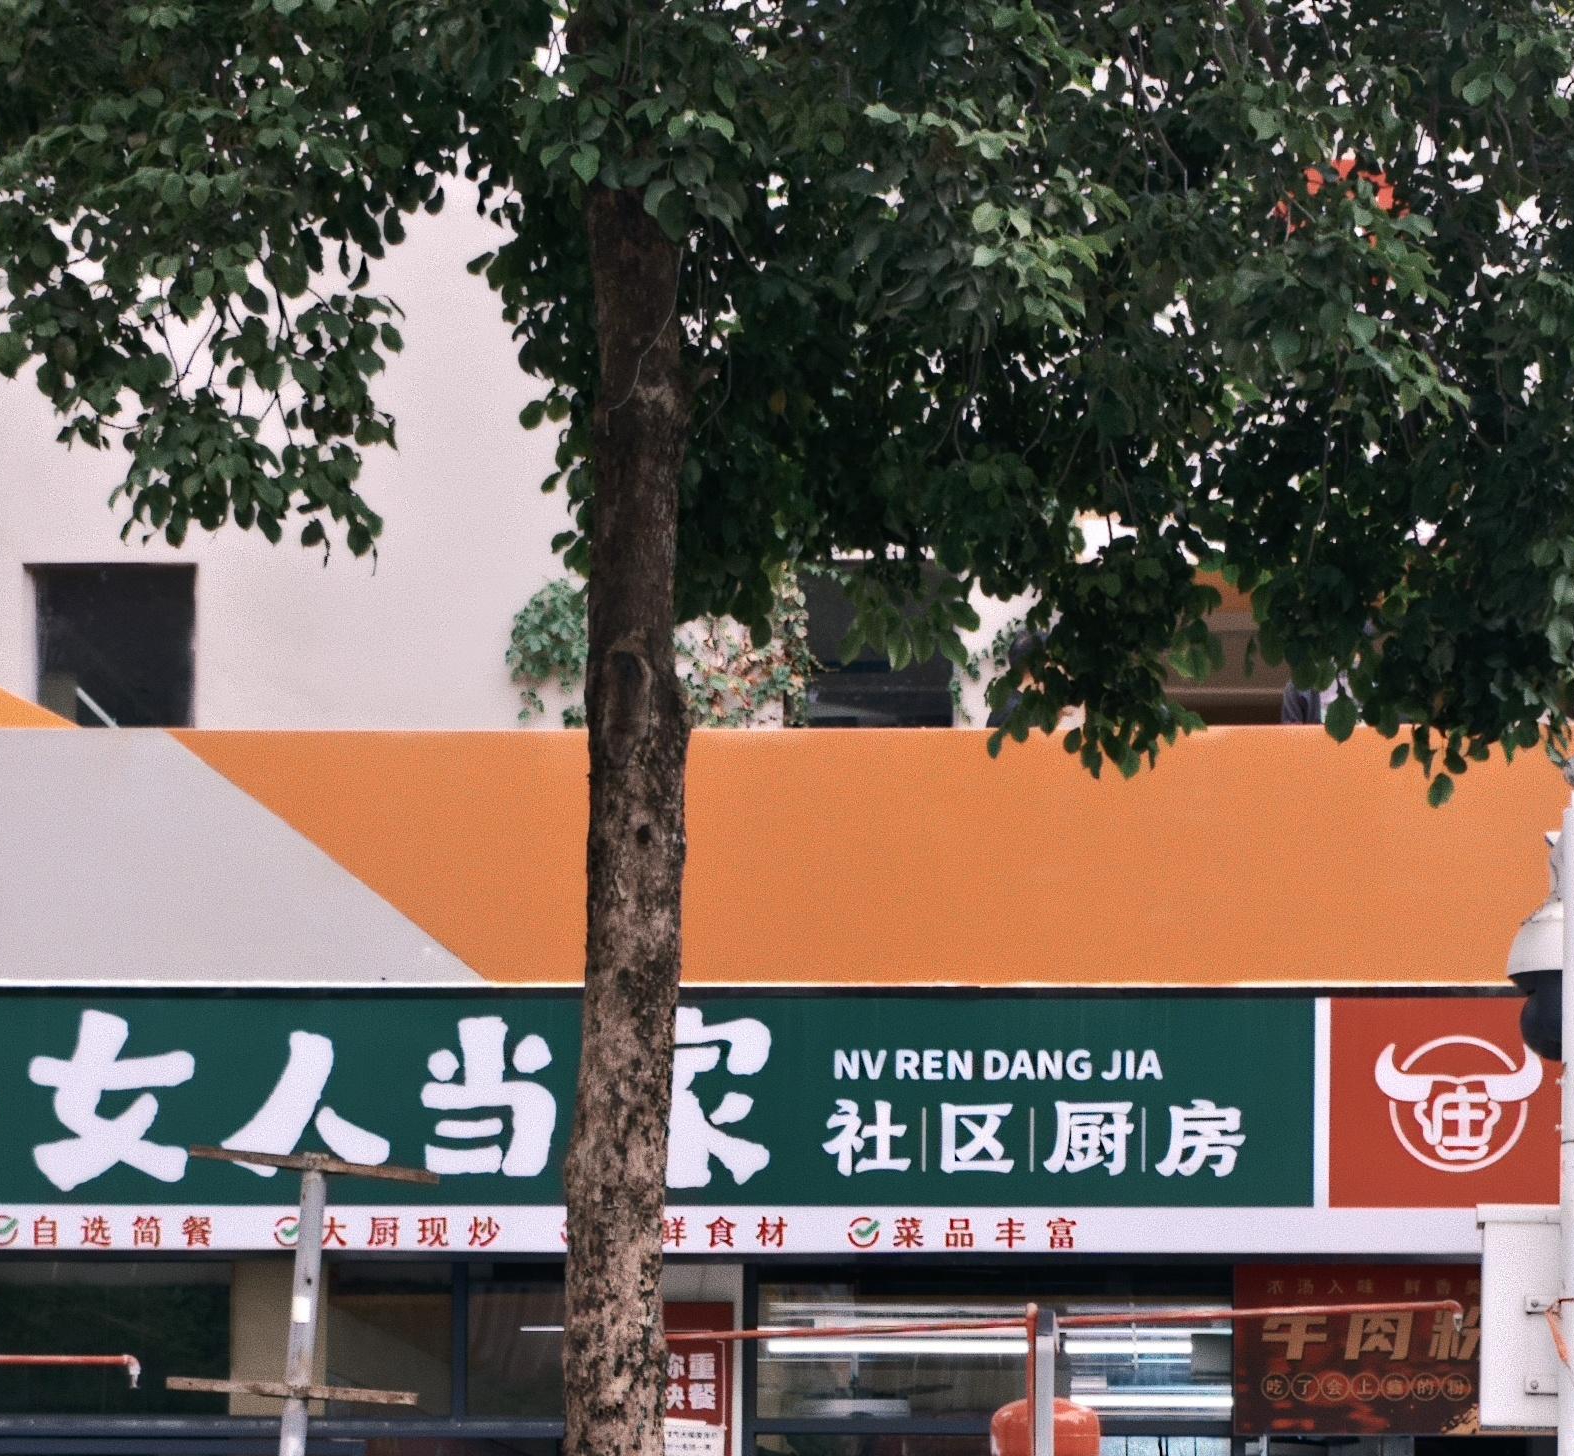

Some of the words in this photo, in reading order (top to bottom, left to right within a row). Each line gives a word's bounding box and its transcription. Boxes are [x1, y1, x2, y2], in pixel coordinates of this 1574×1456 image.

[833, 1050, 887, 1080] NV
[897, 1050, 964, 1080] REN
[991, 1050, 1092, 1080] DANG
[1101, 1050, 1163, 1080] JIA
[28, 1007, 771, 1191] 女人当家
[822, 1099, 1245, 1177] 社区厨房
[33, 1216, 213, 1247] 自选简餐
[322, 1216, 501, 1247] 大厨现炒
[661, 1216, 788, 1247] 鲜食材
[893, 1217, 1077, 1250] 菜品丰富
[1405, 1279, 1481, 1297] 鲜香美
